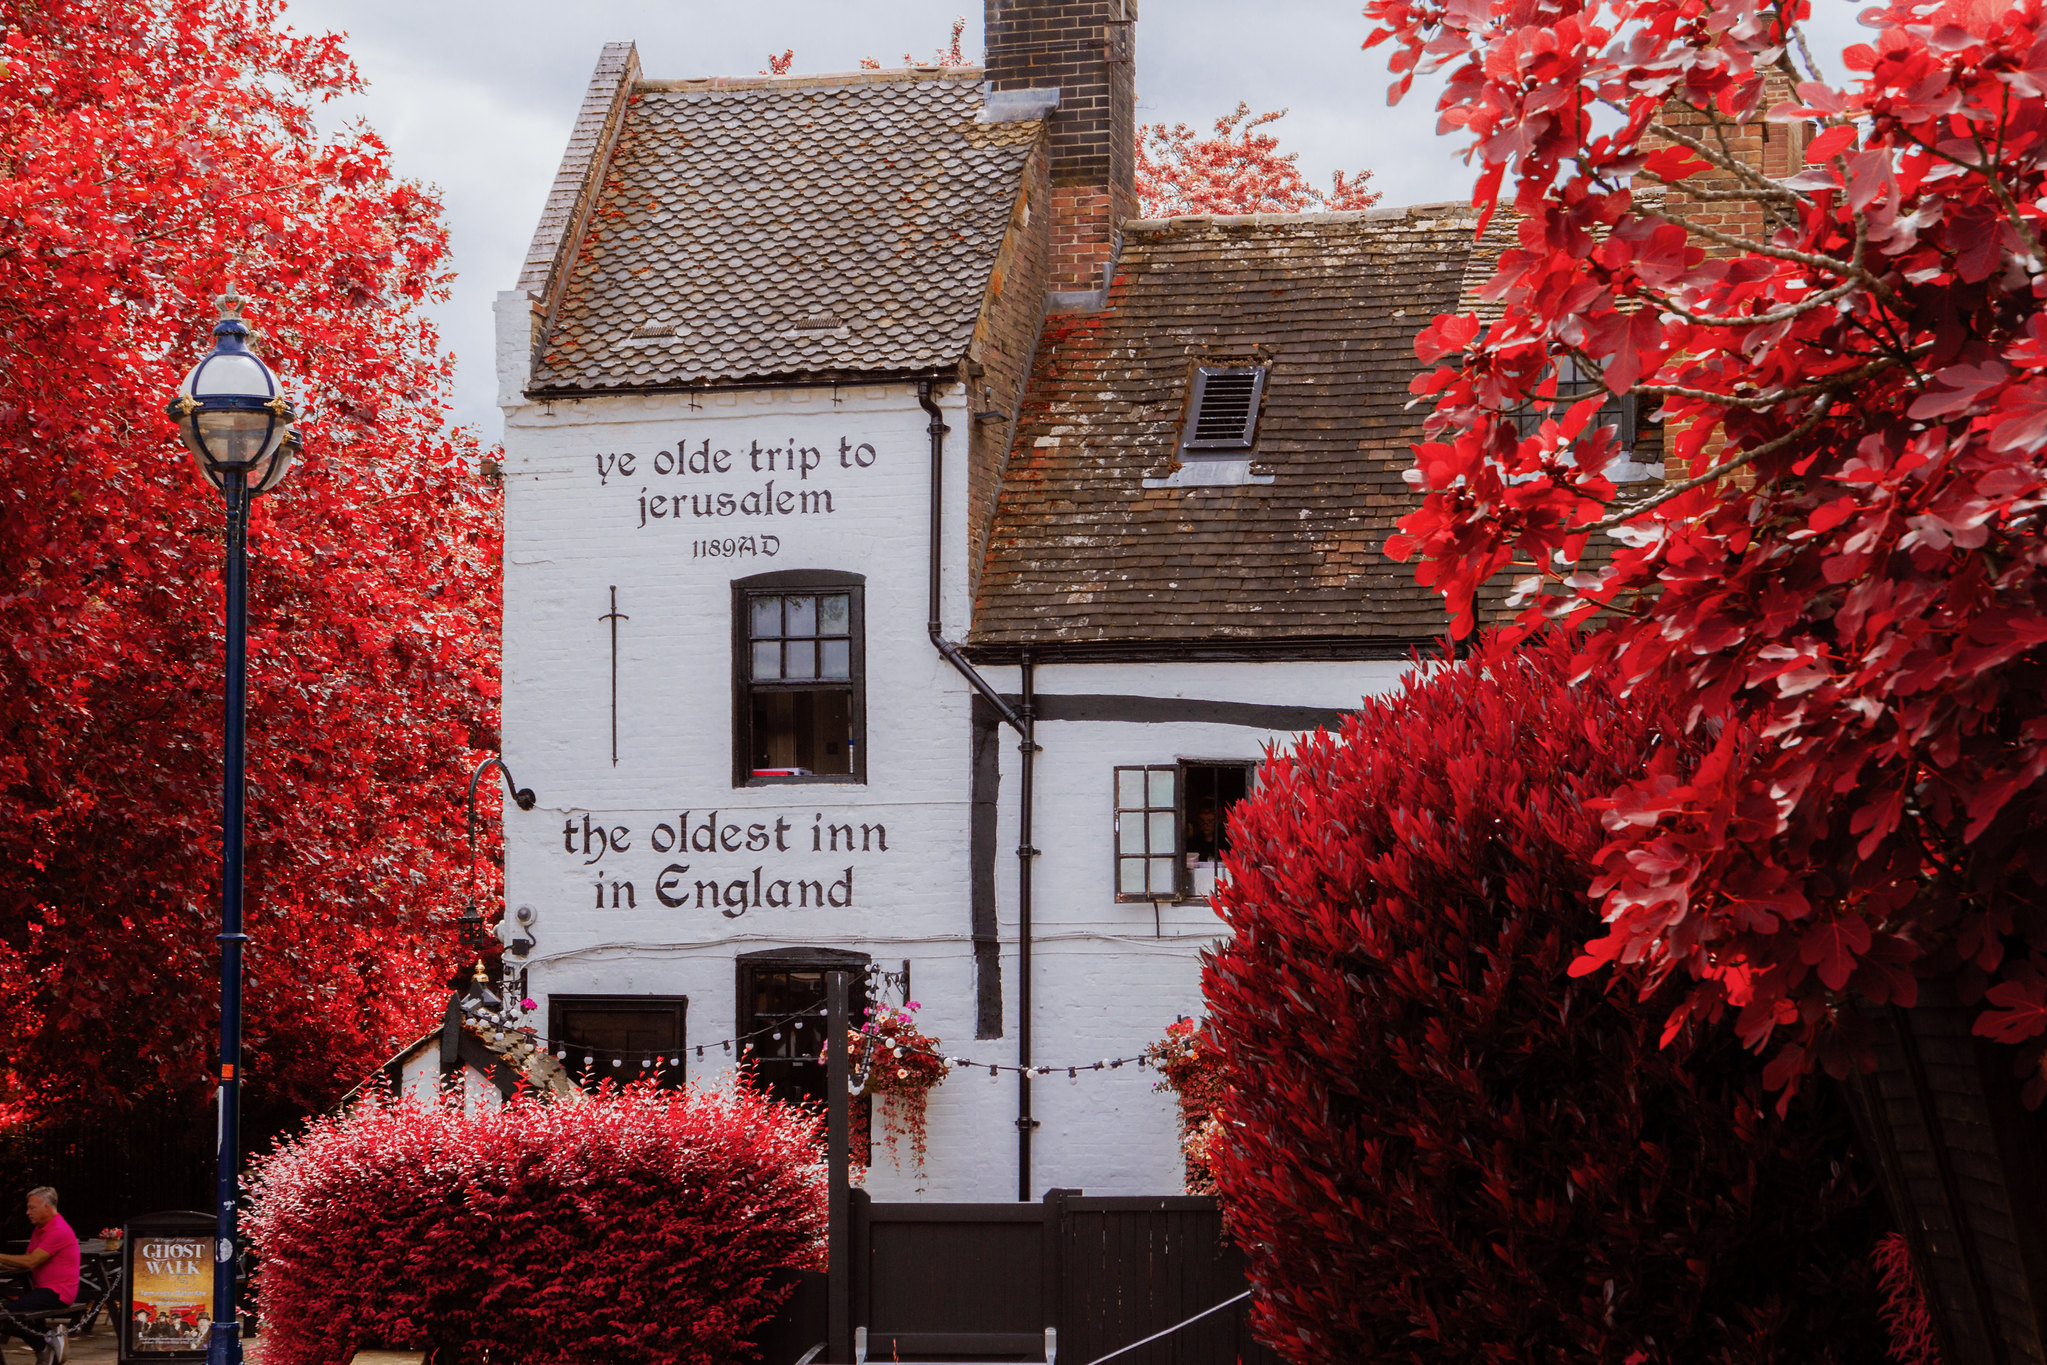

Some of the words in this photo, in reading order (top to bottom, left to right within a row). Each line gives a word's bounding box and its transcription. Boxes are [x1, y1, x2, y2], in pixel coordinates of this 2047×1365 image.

[596, 453, 636, 485] ye
[654, 439, 731, 475] olde
[749, 438, 820, 480] trip
[839, 436, 876, 468] to
[638, 480, 835, 528] jerusalem
[563, 813, 631, 865] the
[651, 811, 791, 853] oldest
[811, 813, 889, 852] inn
[595, 871, 637, 909] in
[656, 864, 853, 919] England
[143, 1244, 205, 1258] GHOST
[146, 1261, 200, 1275] WALK
